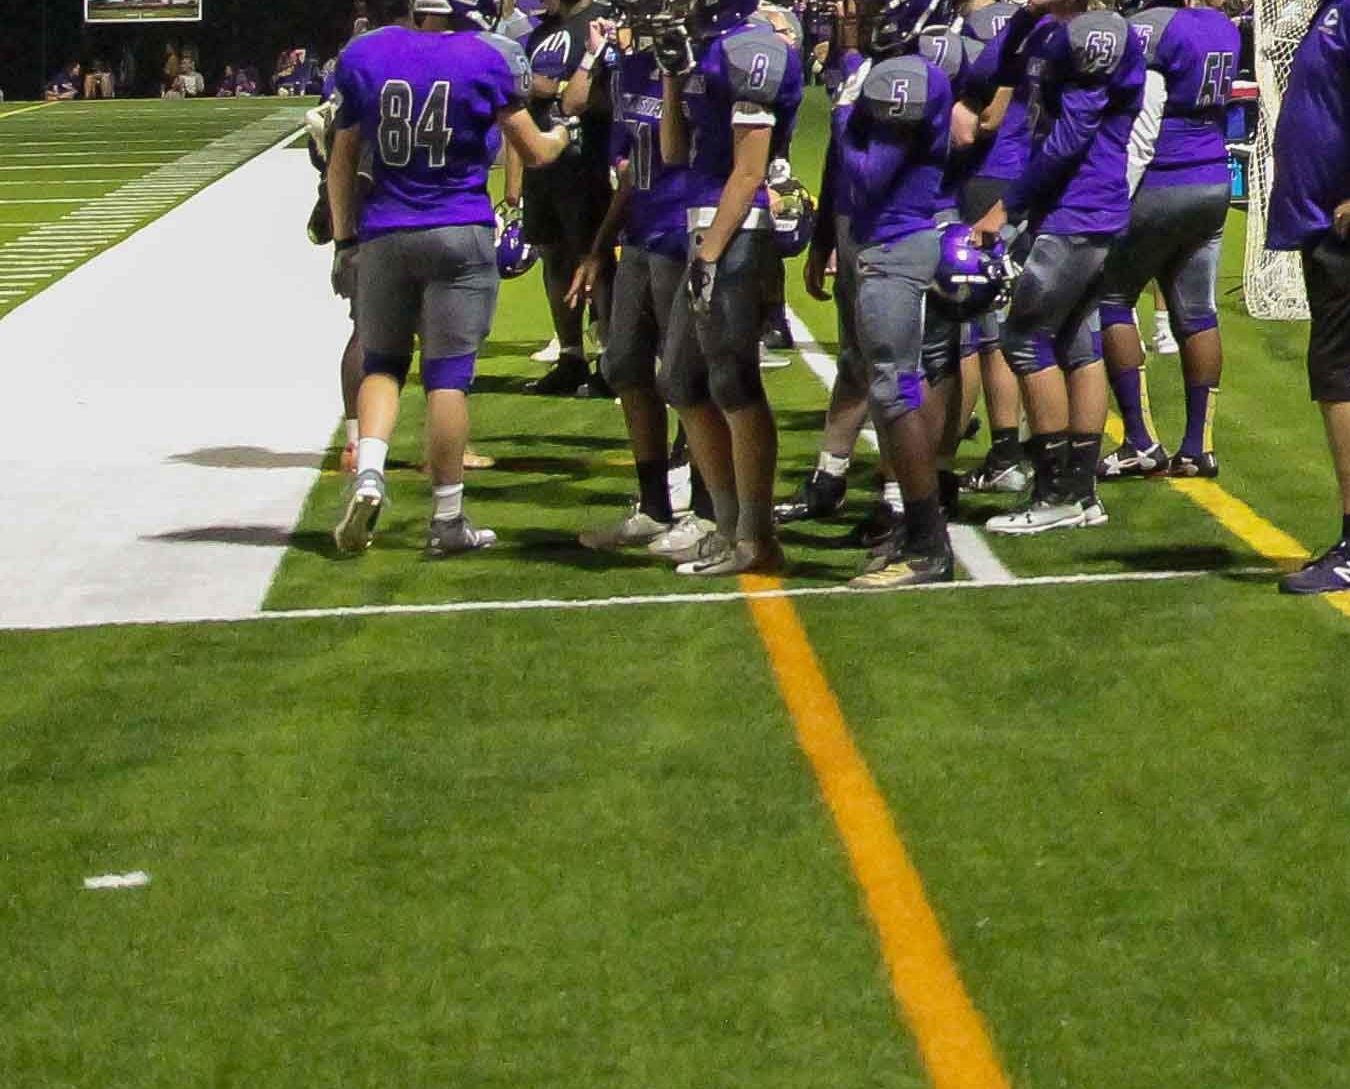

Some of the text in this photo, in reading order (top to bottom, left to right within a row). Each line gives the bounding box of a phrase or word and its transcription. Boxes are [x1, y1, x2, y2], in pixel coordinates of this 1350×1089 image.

[748, 52, 770, 90] 8
[932, 36, 949, 68] 7
[888, 78, 909, 117] 5
[380, 79, 453, 168] 84
